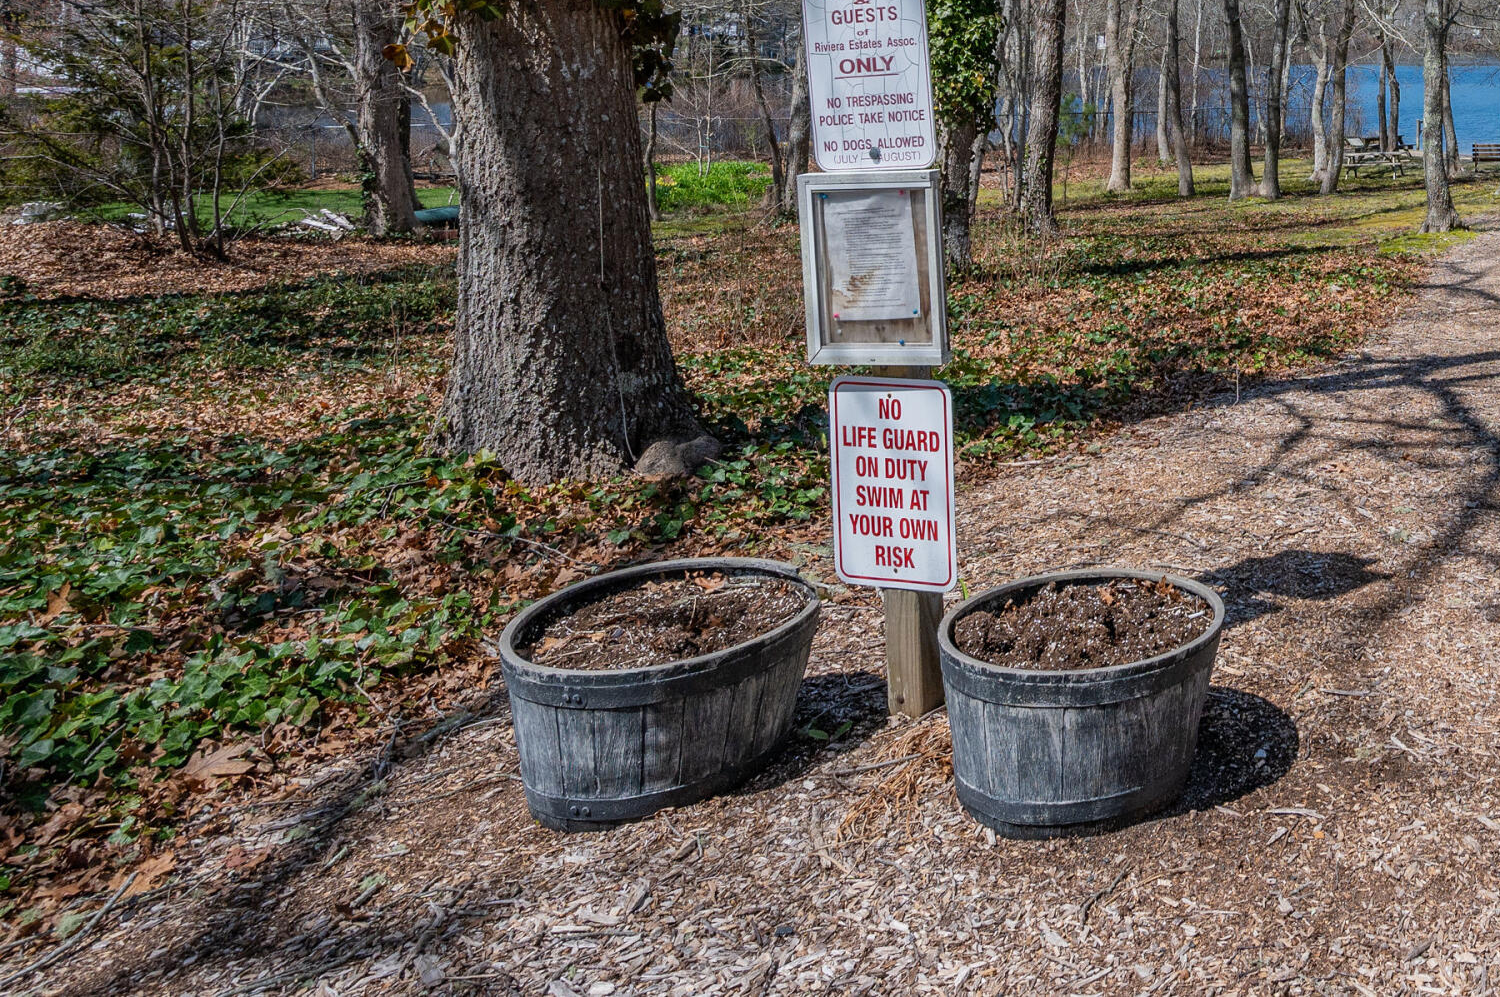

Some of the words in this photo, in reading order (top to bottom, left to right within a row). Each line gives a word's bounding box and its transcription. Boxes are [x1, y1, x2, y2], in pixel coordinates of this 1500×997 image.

[831, 6, 898, 25] GUESTS
[815, 41, 844, 53] Riviera
[849, 40, 882, 50] Estates
[887, 37, 918, 48] Assoc.
[839, 56, 895, 74] ONLY
[827, 97, 841, 109] NO
[846, 93, 914, 107] TRESPASSING
[819, 114, 854, 127] POLICE
[859, 112, 883, 123] TAKE
[888, 109, 925, 122] NOTICE
[824, 141, 838, 152] NO
[843, 139, 872, 151] DOGS
[878, 136, 924, 148] ALLOWED
[834, 154, 858, 164] (JULY
[878, 398, 902, 420] NO
[842, 425, 877, 448] LIFE
[882, 428, 940, 452] GUARD
[856, 456, 878, 478] ON
[885, 457, 928, 481] DUTY
[856, 485, 904, 509] SWIM
[910, 489, 929, 511] AT
[849, 513, 893, 538] YOUR
[899, 517, 939, 542] OWN
[875, 545, 915, 569] RISK
